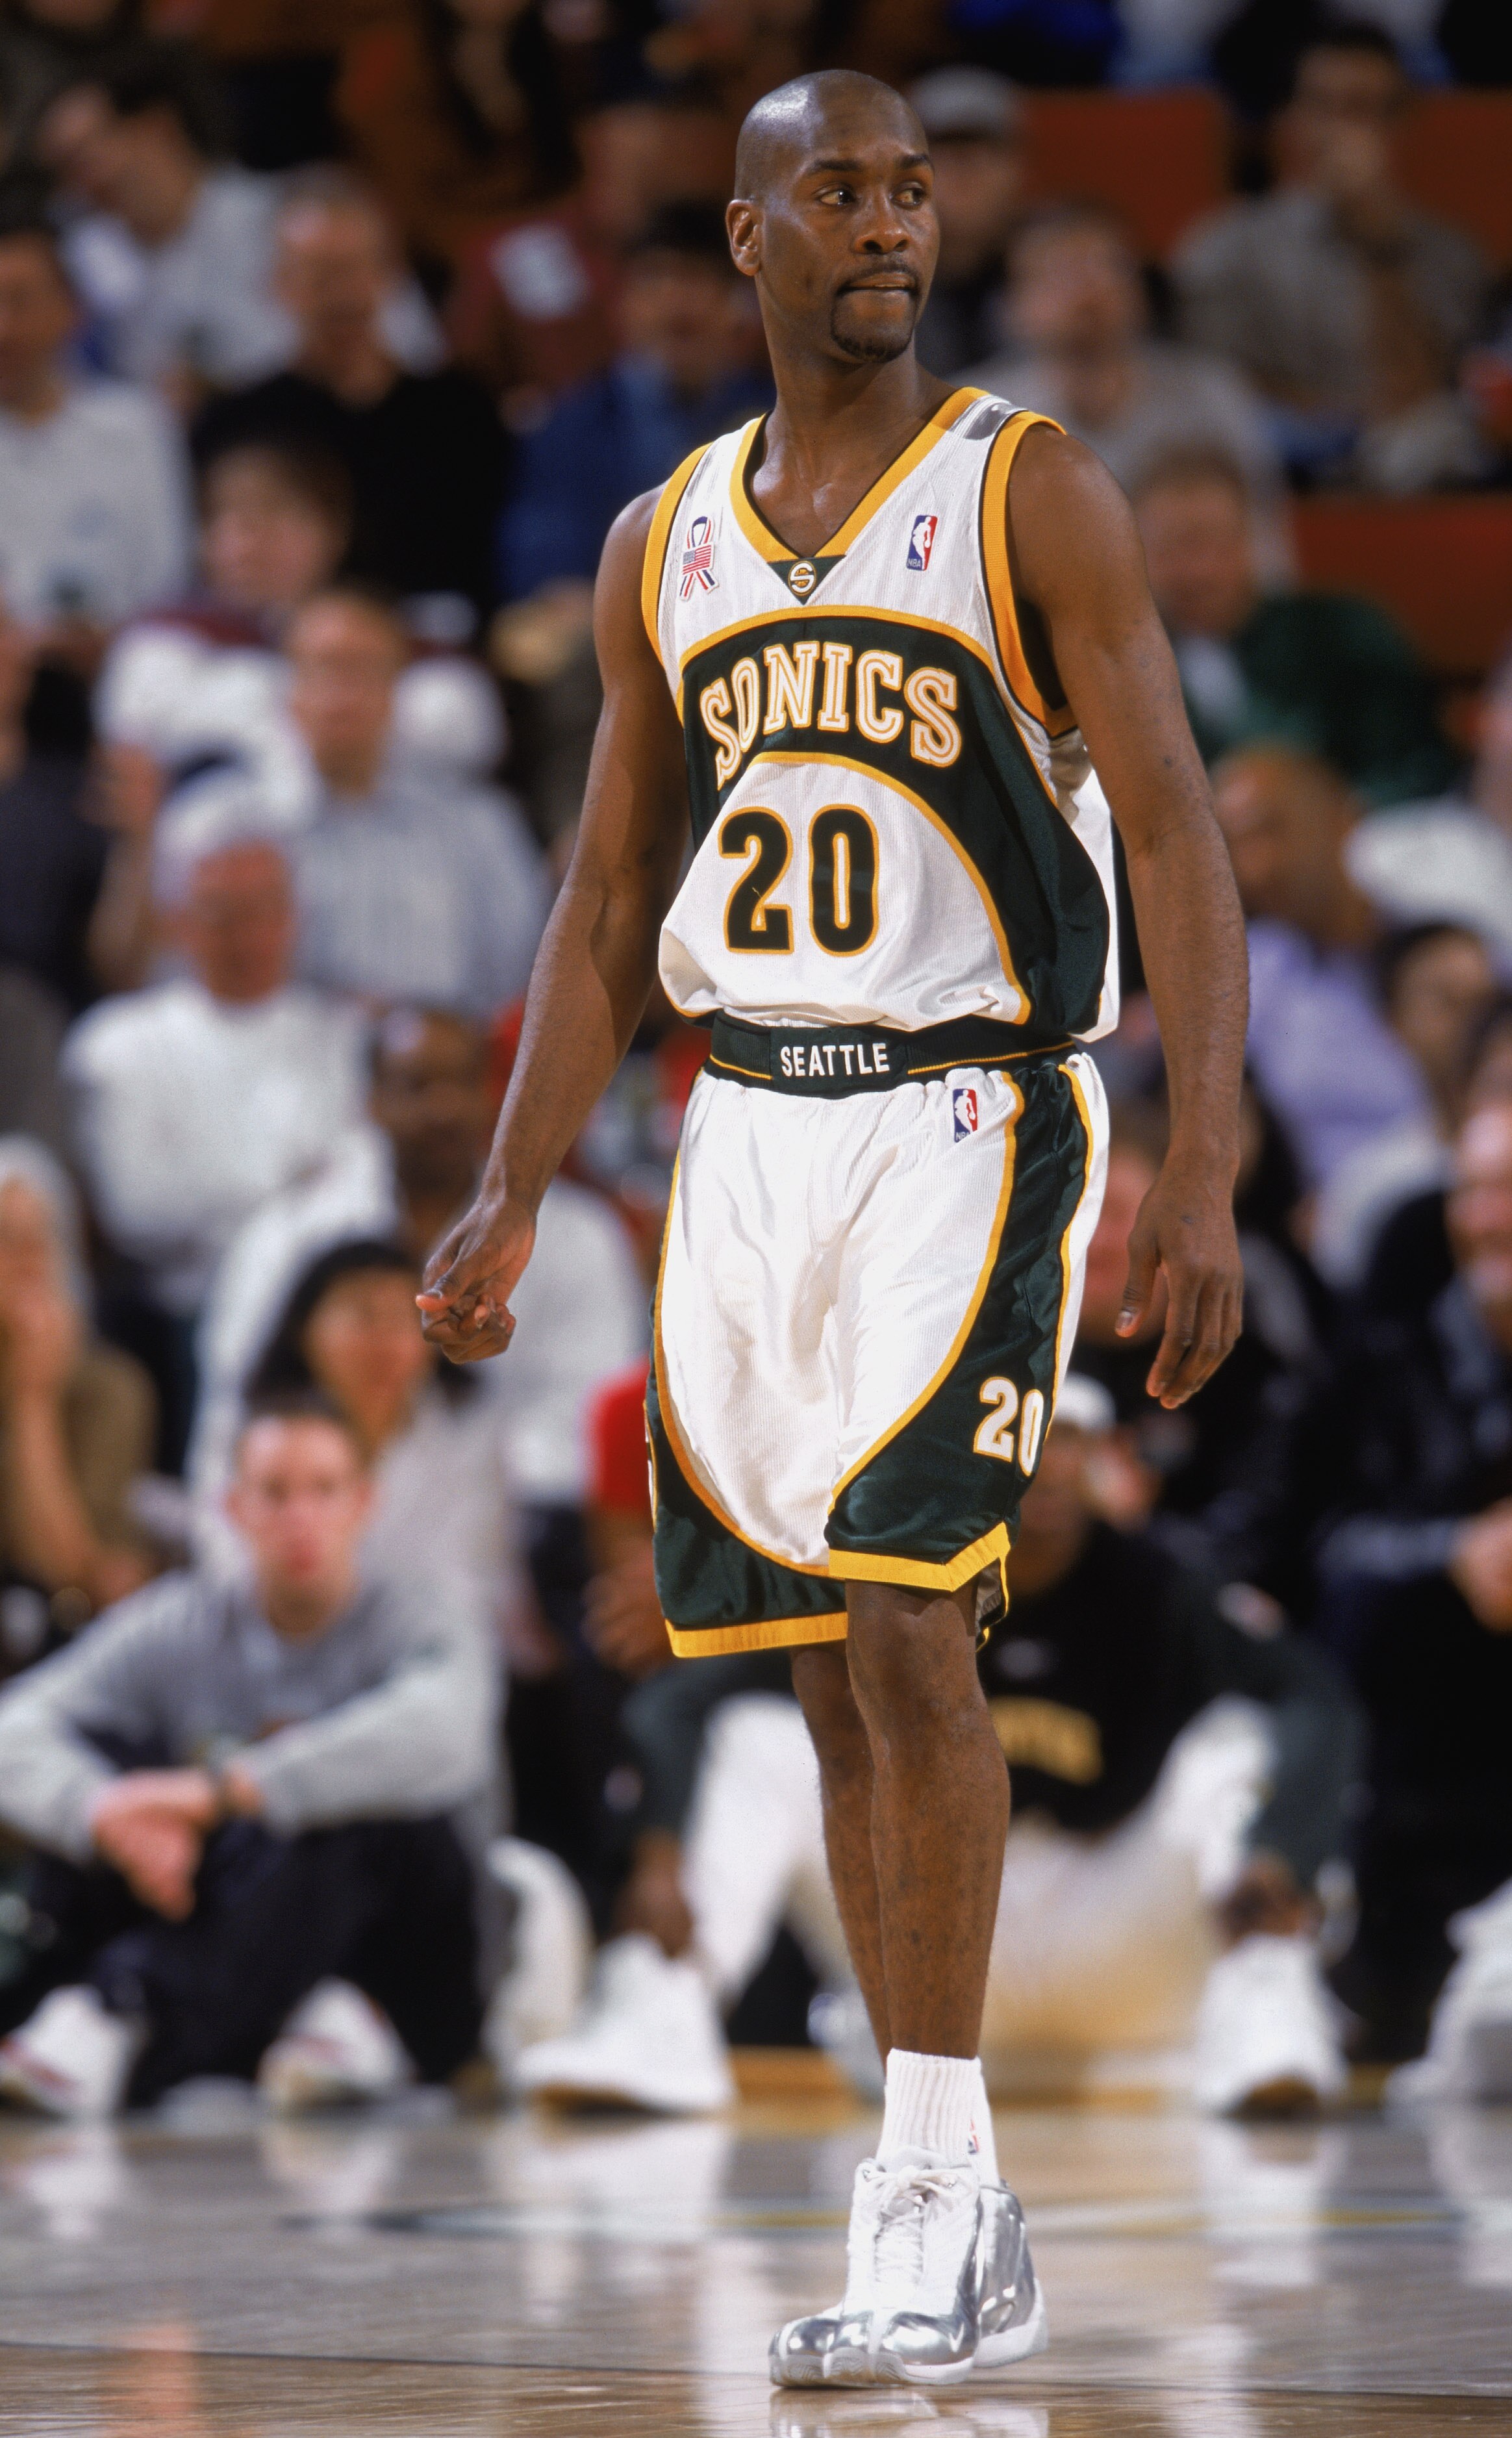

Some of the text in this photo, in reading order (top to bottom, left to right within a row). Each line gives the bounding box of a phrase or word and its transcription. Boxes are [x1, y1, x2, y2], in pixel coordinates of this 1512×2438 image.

[907, 559, 921, 567] NBA
[699, 641, 962, 791] SONICS
[718, 804, 879, 957] 20
[780, 1043, 890, 1076] SEATTLE
[973, 1376, 1044, 1477] 20
